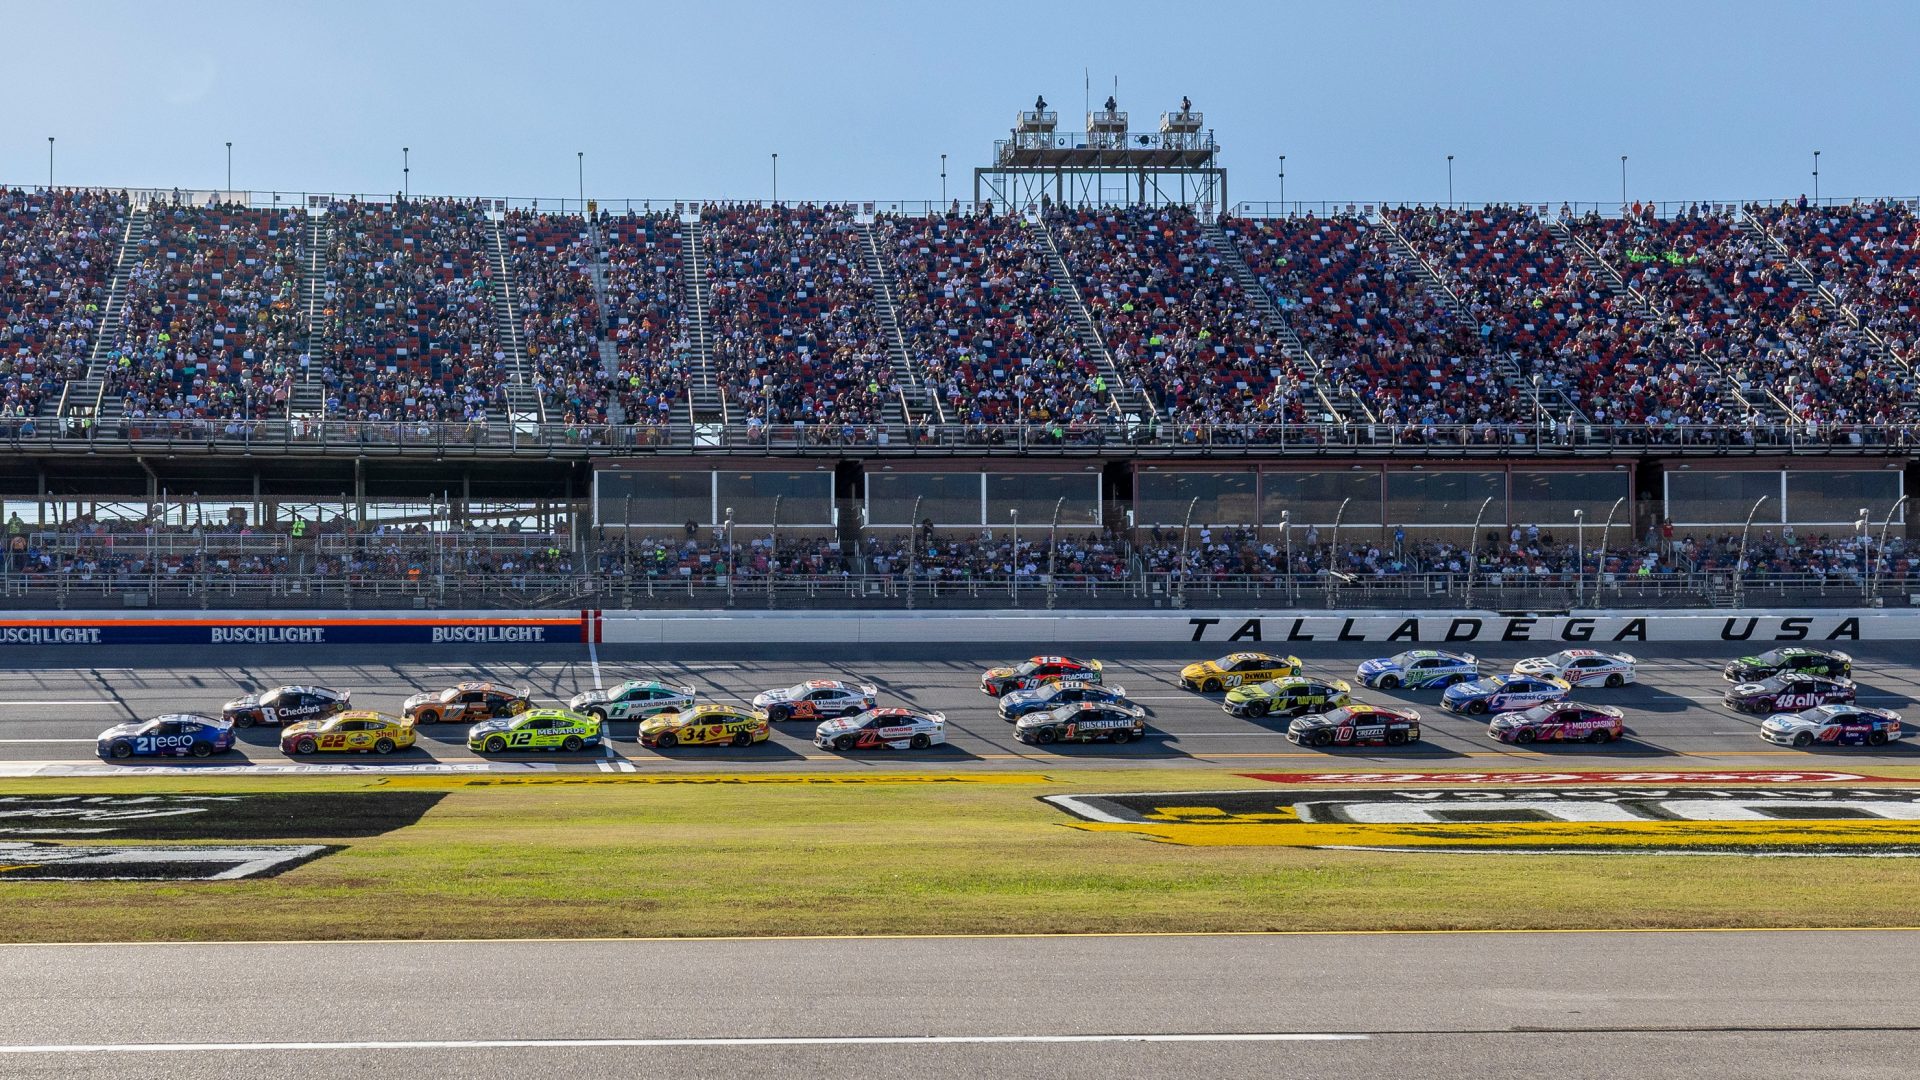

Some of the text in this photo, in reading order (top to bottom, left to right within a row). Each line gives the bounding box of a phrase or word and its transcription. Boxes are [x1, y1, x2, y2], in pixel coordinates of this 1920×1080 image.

[1188, 617, 1860, 641] TALLADEGA USA
[1061, 672, 1094, 681] TRACKER
[1225, 674, 1243, 687] 20
[1023, 679, 1040, 690] 19
[1269, 698, 1289, 711] 24
[1297, 695, 1325, 705] RAPTOR
[1491, 696, 1506, 707] 5
[1775, 694, 1794, 708] 48
[1795, 693, 1825, 706] ally
[794, 700, 814, 715] 33
[261, 707, 279, 722] 8
[375, 730, 398, 738] Shell
[537, 727, 586, 736] MENARDS
[683, 728, 706, 741] 34
[1065, 723, 1076, 738] 1
[1334, 726, 1354, 742] 10
[136, 737, 156, 751] 21
[156, 734, 194, 747] eero
[321, 734, 347, 748] 22
[510, 732, 533, 745] 12
